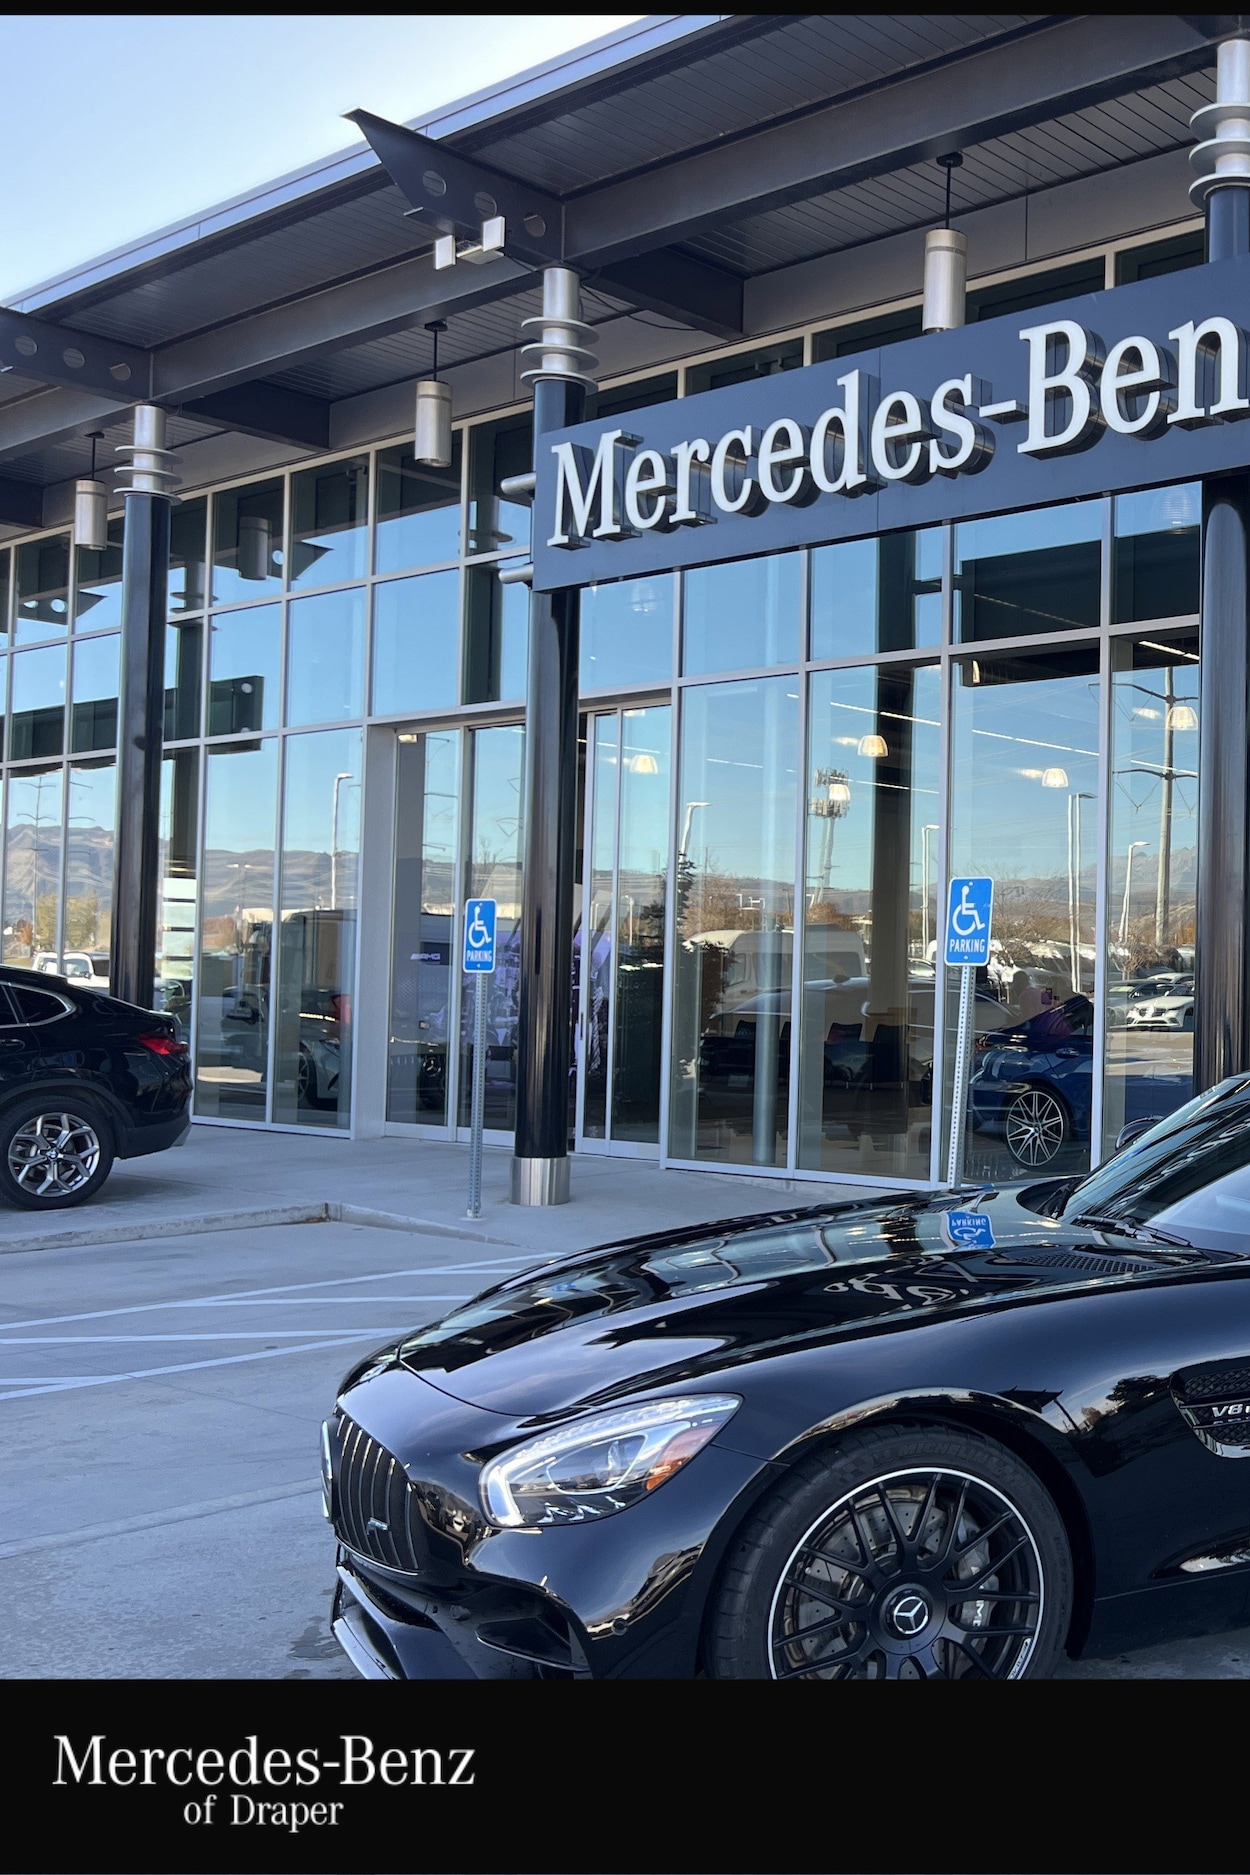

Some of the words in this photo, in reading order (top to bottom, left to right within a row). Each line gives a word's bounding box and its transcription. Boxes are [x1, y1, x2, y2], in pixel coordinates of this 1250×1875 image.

[949, 938, 986, 953] PARKING
[466, 949, 492, 963] PARKING
[1211, 1403, 1244, 1418] V8
